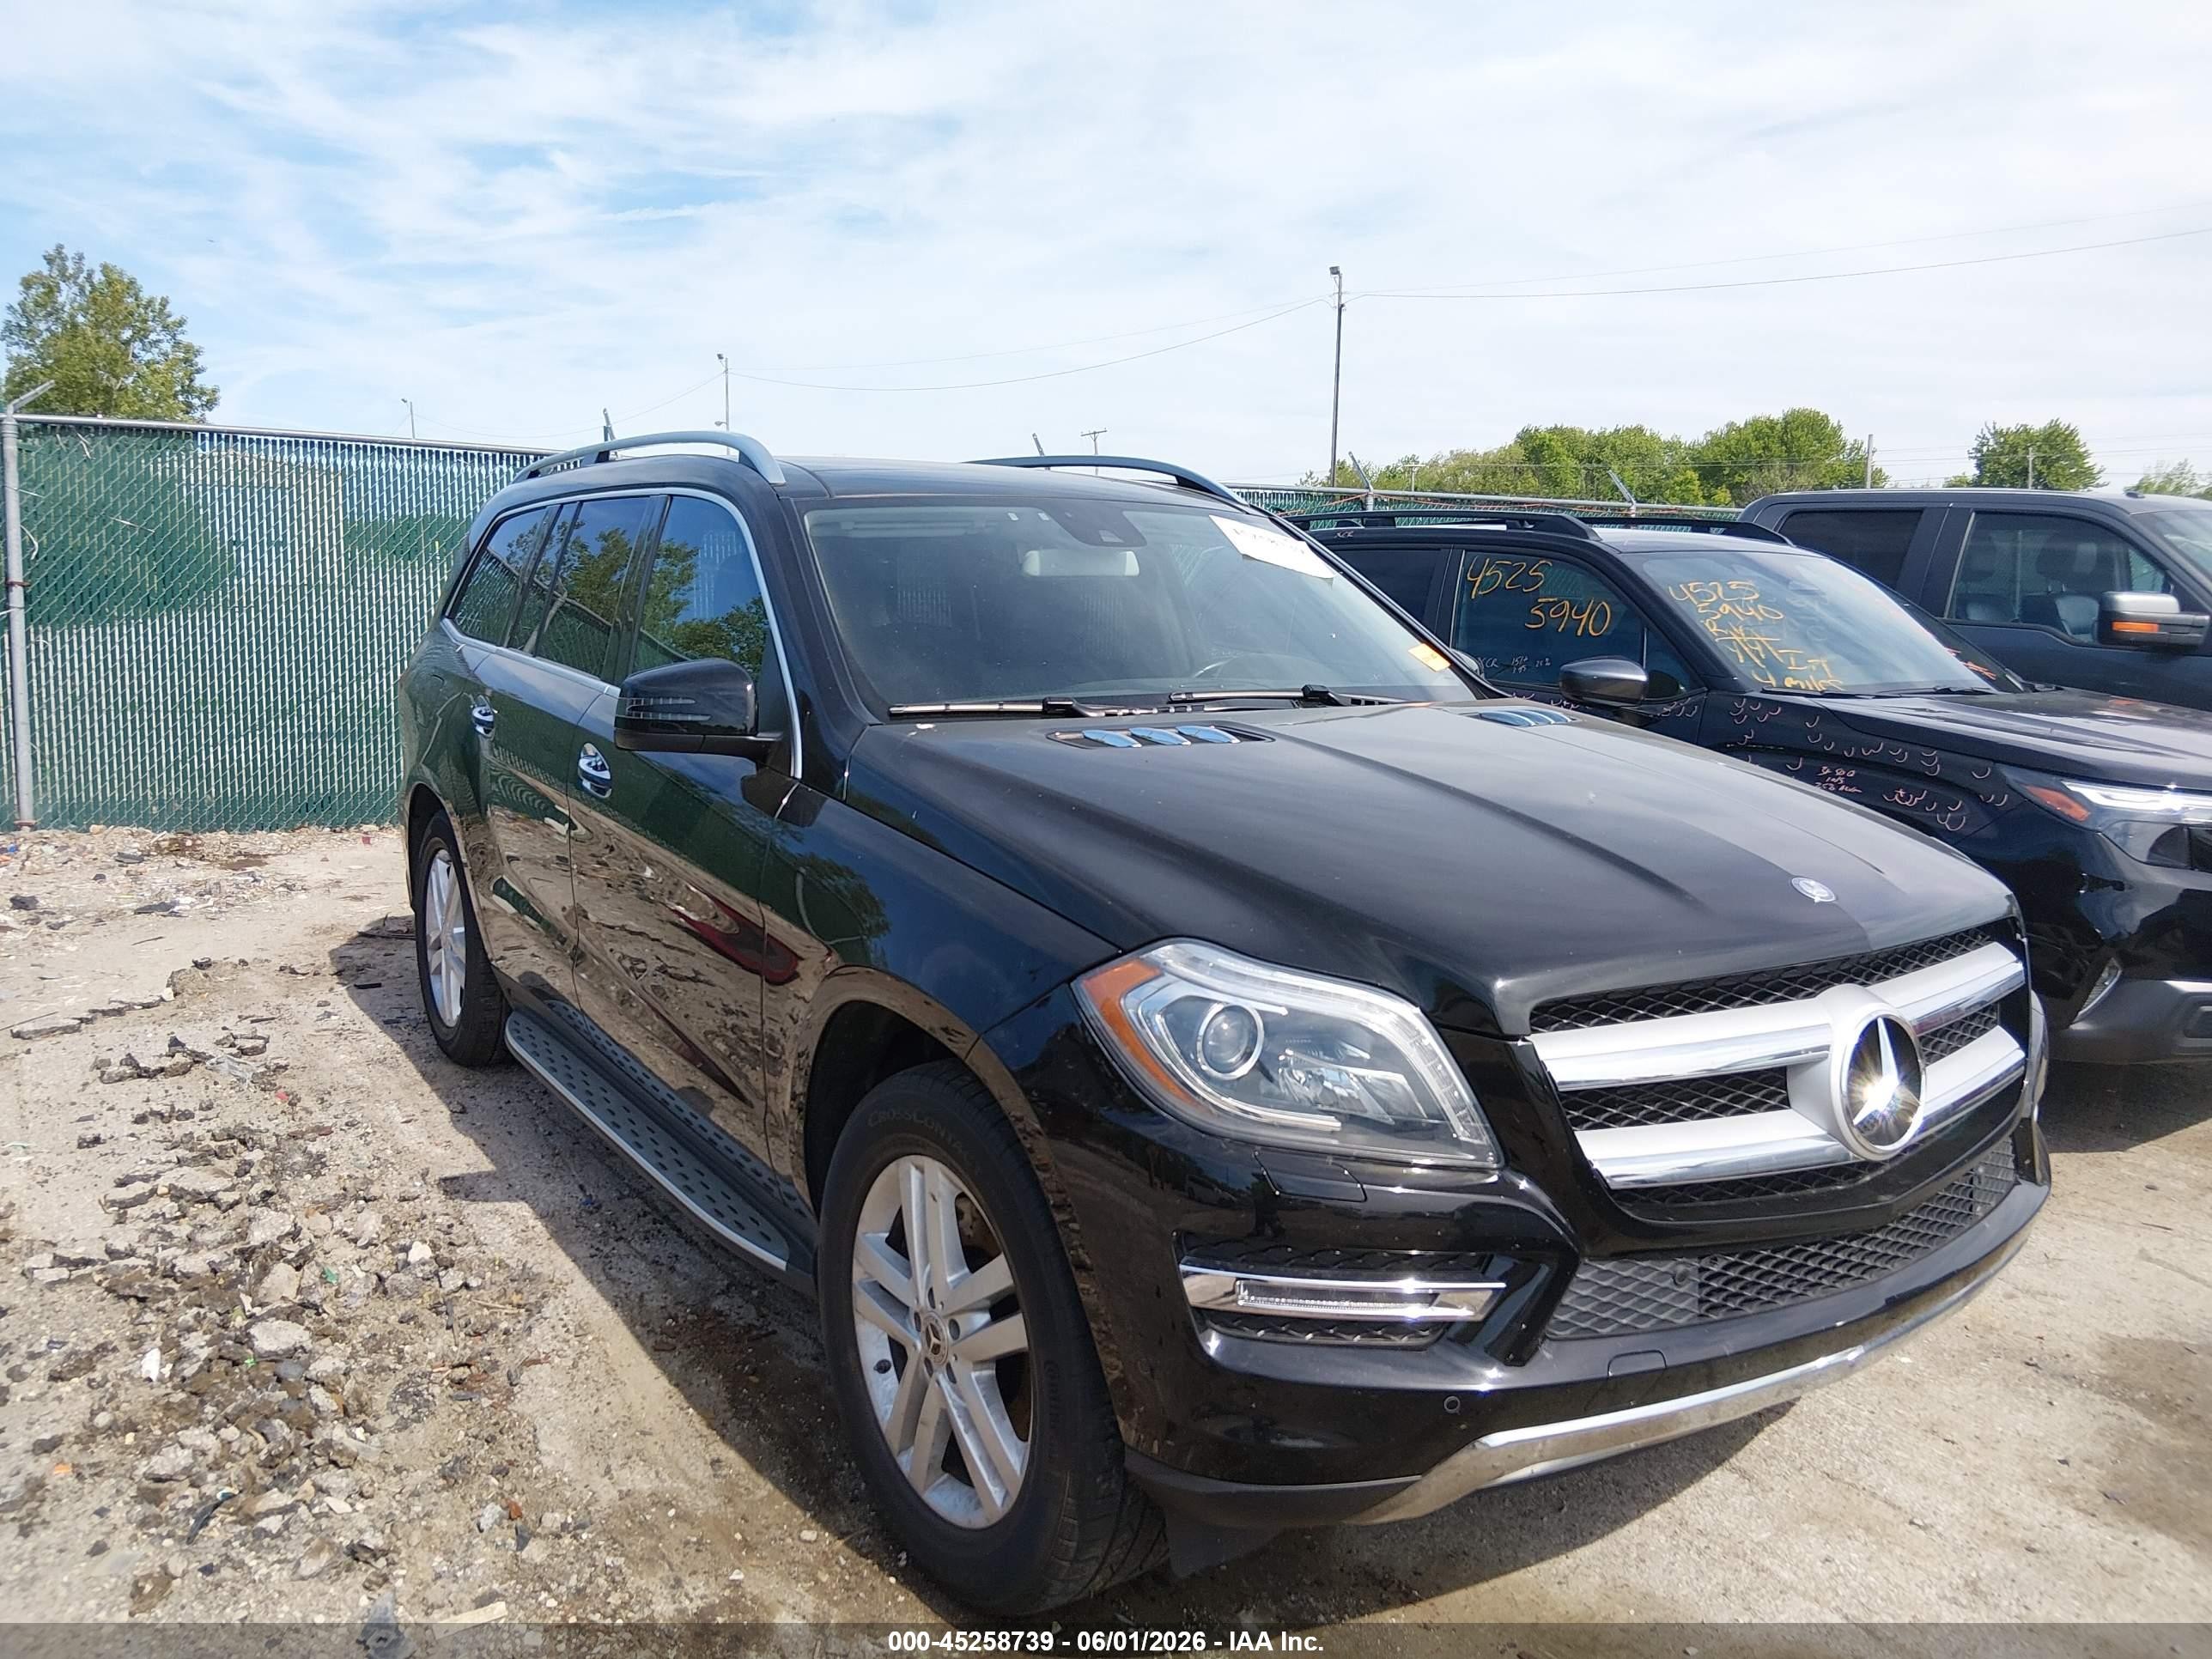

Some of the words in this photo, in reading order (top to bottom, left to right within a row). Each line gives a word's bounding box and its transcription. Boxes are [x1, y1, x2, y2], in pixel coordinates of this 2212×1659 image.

[1467, 556, 1553, 599] 4525
[1668, 581, 1759, 605] 4525
[1525, 598, 1611, 636] 5940
[1697, 601, 1784, 621] 5940
